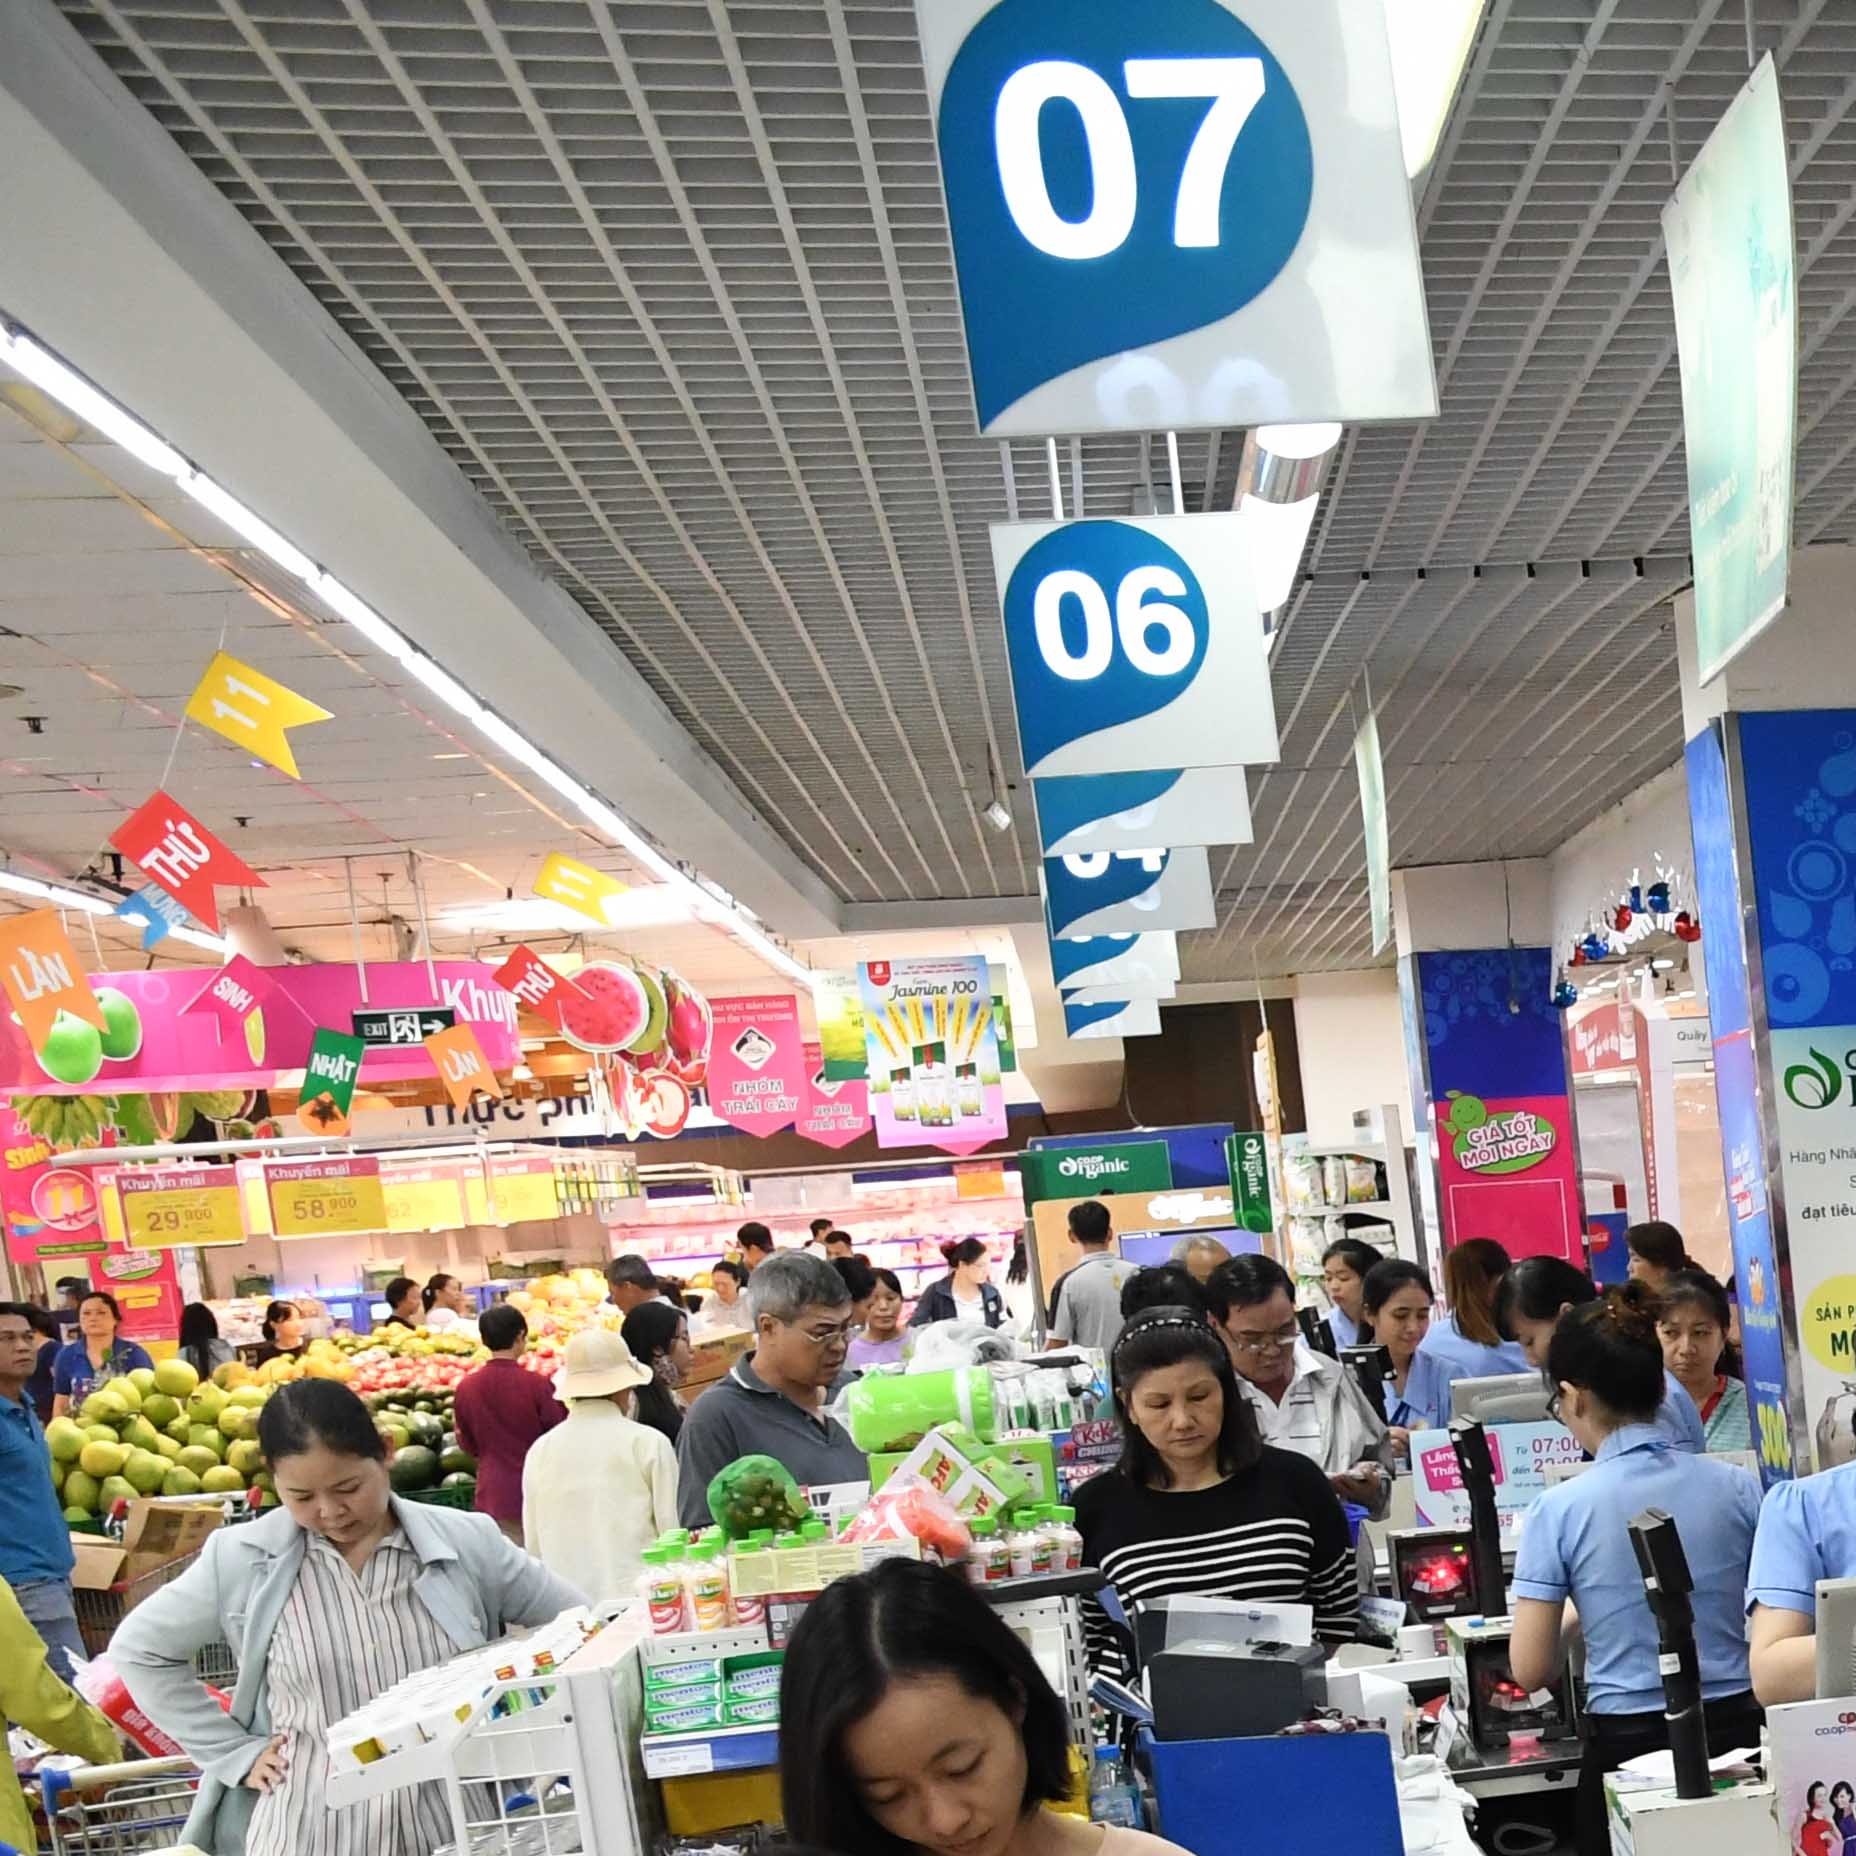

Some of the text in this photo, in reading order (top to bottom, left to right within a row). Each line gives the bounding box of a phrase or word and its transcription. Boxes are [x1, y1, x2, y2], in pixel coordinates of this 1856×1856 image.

[992, 56, 1267, 262] 07
[1030, 566, 1198, 682] 06
[211, 674, 272, 729] 11
[138, 817, 213, 889] THỨ
[8, 945, 75, 1001] LẦN
[512, 963, 557, 1006] THỨ
[211, 974, 257, 1014] SINH
[889, 979, 979, 1002] Jasmine 100
[309, 1052, 358, 1086] NHẬT
[732, 1077, 784, 1096] NHÓM
[721, 1096, 800, 1115] TRÁI CÂY
[1467, 1112, 1537, 1145] GIÁ TỐT
[1461, 1132, 1554, 1170] MỖI NGÀY
[1789, 1150, 1828, 1165] Hàng
[268, 1164, 324, 1182] Khuyến
[1800, 1205, 1827, 1223] đạt
[1815, 1303, 1843, 1323] SẢN
[654, 1660, 714, 1682] mentos
[652, 1682, 713, 1703] mentos
[653, 1703, 713, 1725] mentos
